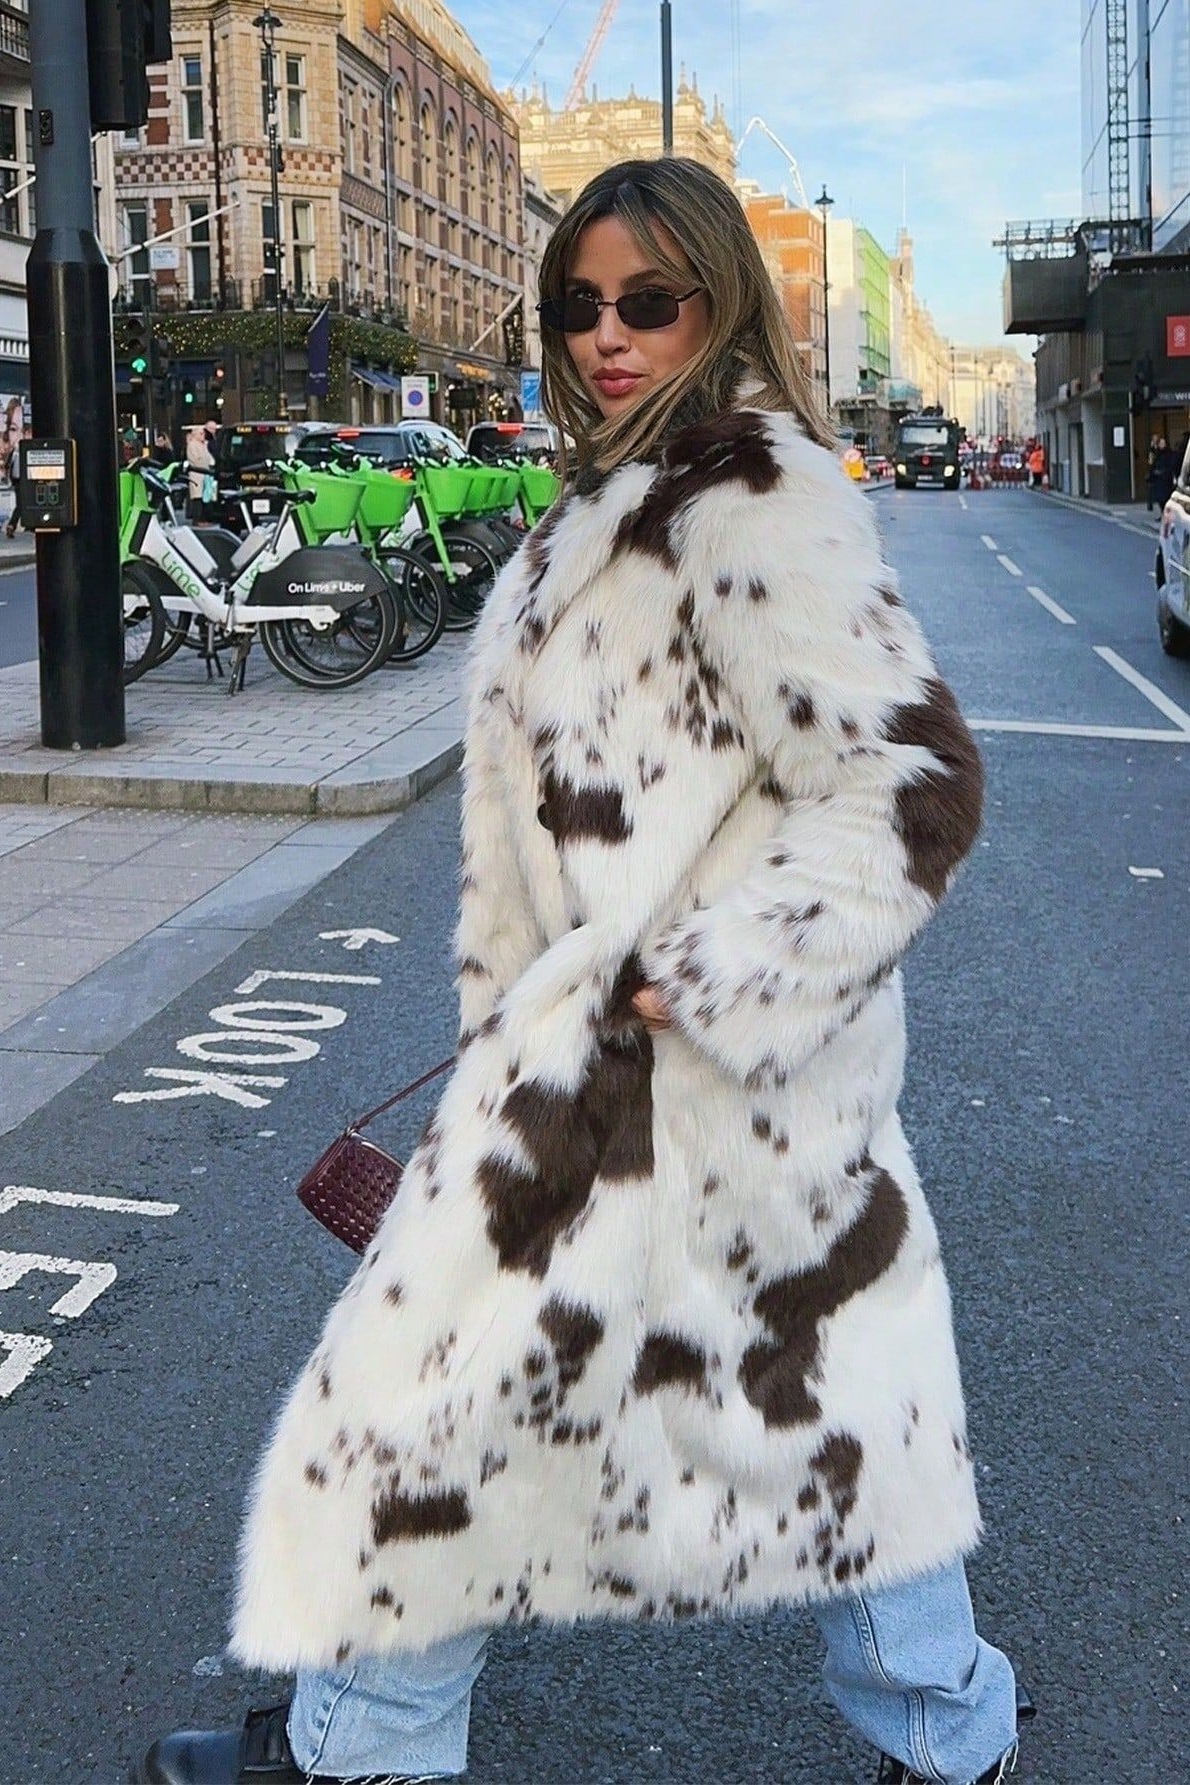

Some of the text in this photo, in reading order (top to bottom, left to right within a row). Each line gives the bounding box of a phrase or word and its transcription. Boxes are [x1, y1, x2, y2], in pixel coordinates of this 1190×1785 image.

[161, 551, 201, 599] Lime
[288, 582, 304, 594] On
[340, 581, 366, 592] Uber
[112, 970, 382, 1108] LOOK
